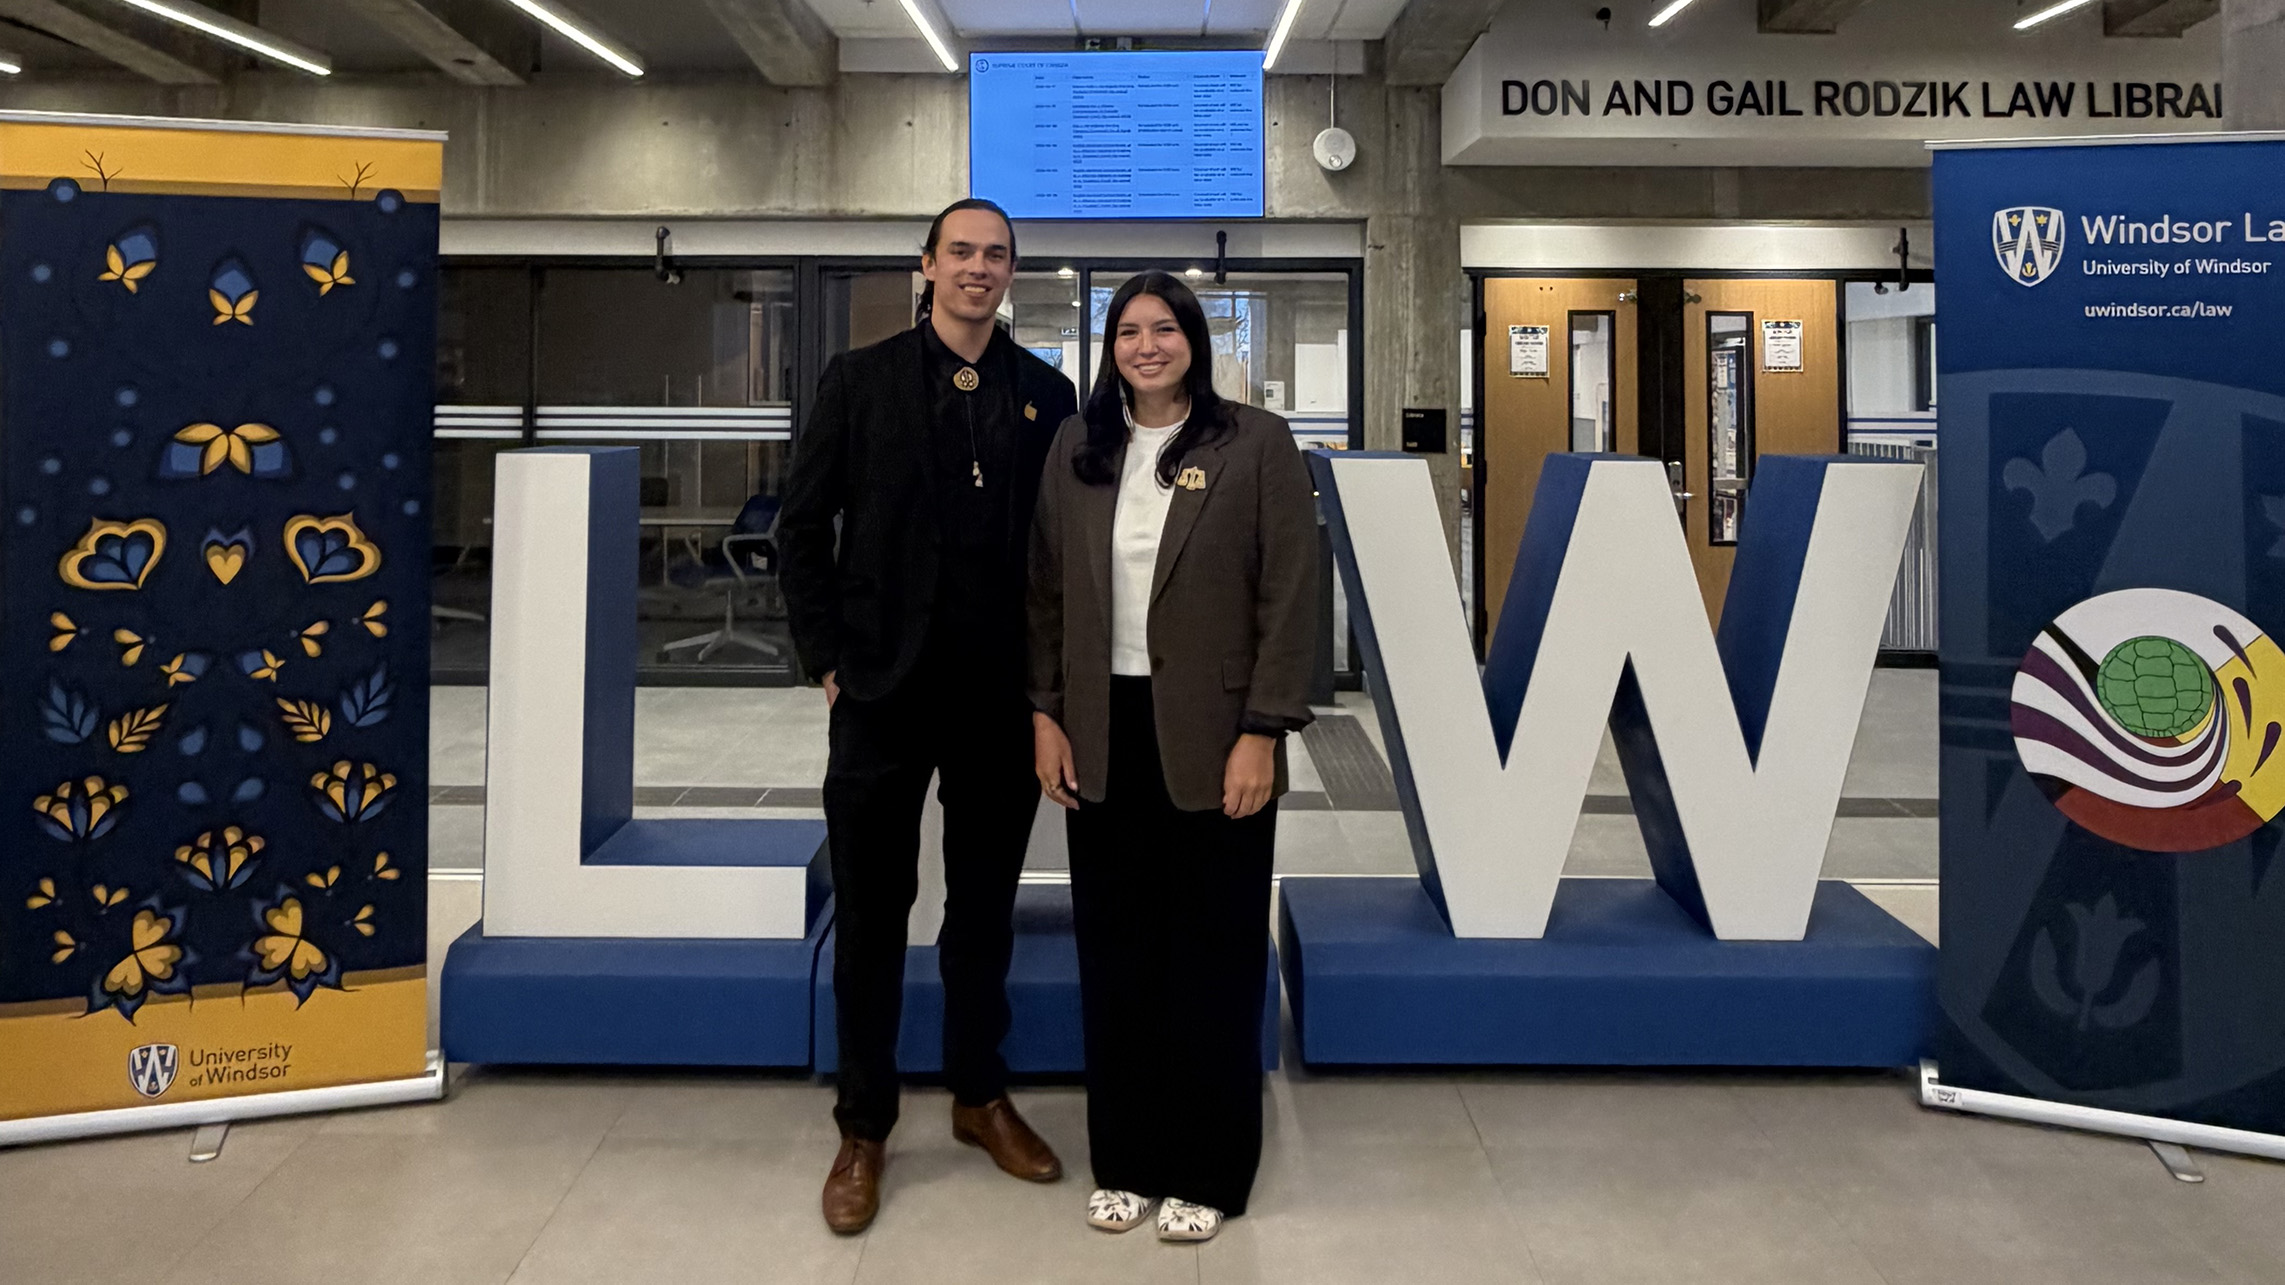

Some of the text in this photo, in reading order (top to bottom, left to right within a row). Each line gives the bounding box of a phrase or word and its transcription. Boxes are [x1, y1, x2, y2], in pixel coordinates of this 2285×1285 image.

[1502, 79, 1590, 116] DON
[1602, 79, 1694, 116] AND
[1706, 80, 1804, 117] GAIL
[1813, 80, 1971, 118] RODZIK
[1981, 81, 2076, 118] LAW
[2081, 213, 2233, 245] Windsor
[2082, 257, 2272, 278] University of Windsor
[2084, 301, 2233, 318] uwindsor.ca/law
[189, 1042, 293, 1068] University
[189, 1063, 292, 1088] of Windsor
